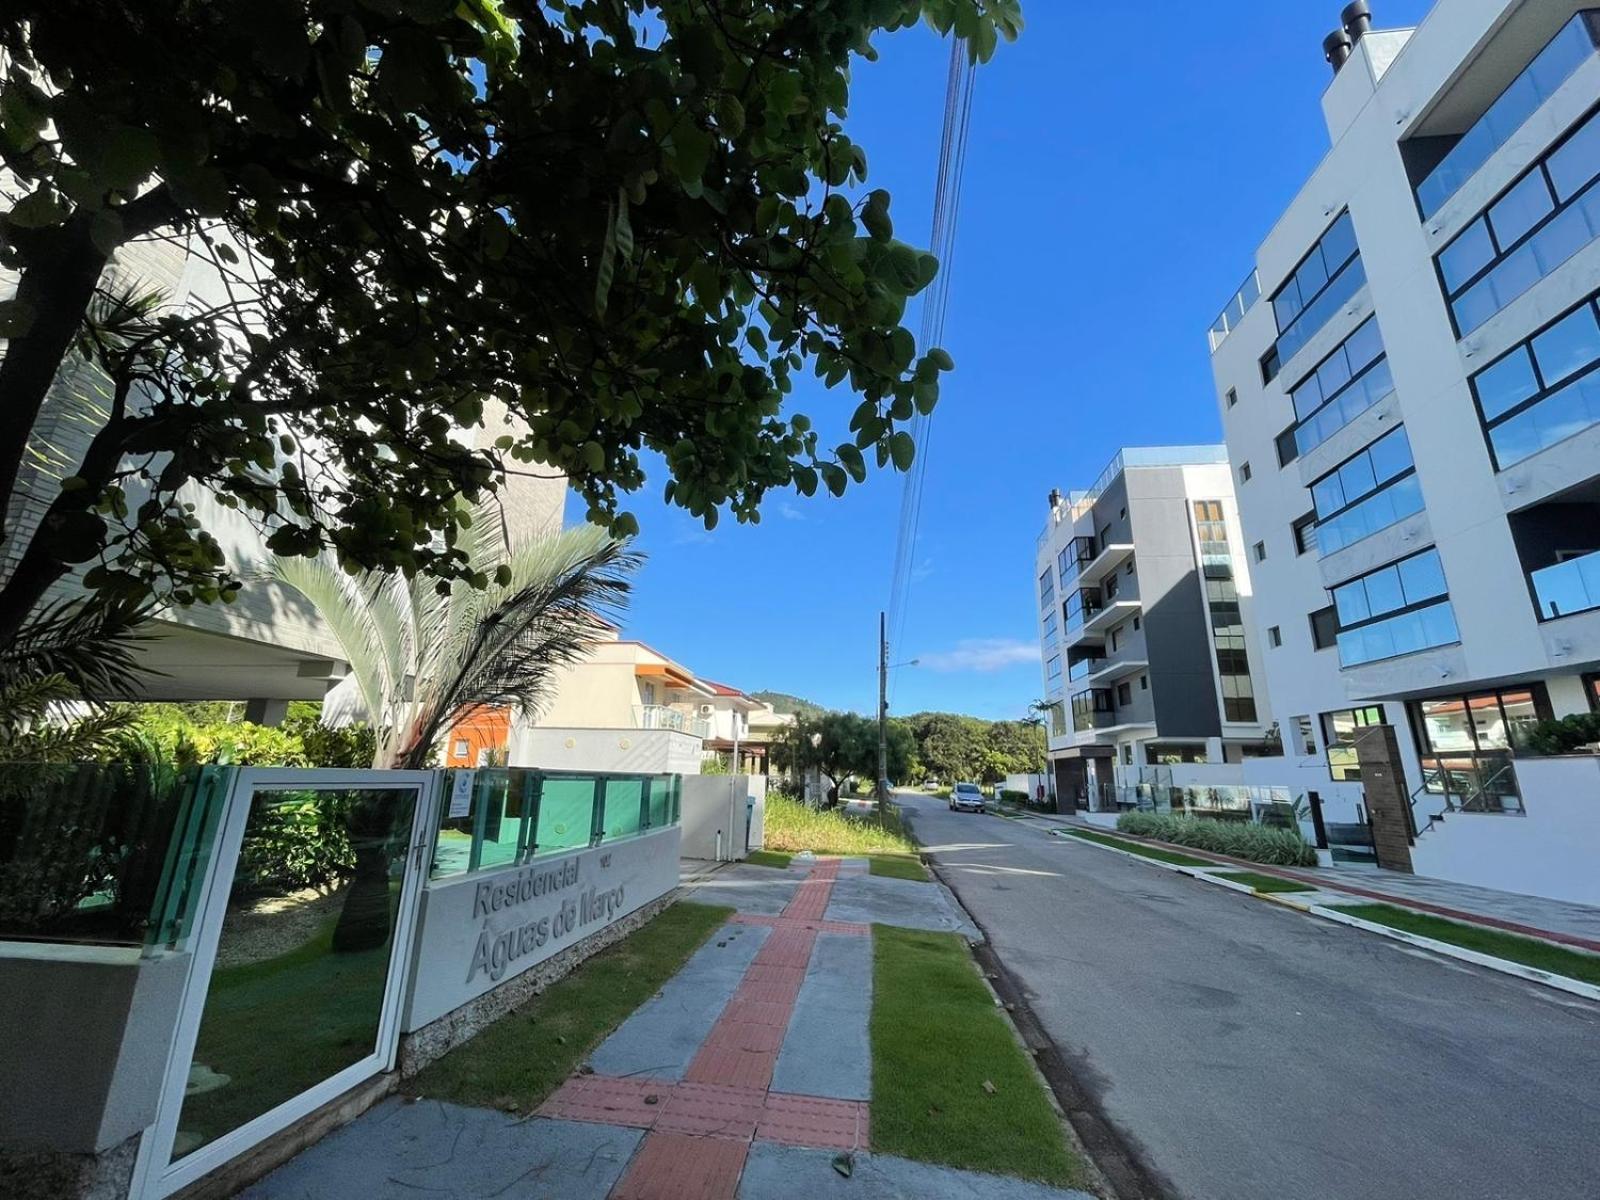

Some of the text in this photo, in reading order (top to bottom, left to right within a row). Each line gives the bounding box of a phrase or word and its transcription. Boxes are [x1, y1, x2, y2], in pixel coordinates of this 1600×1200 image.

[472, 855, 580, 919] Residencial
[465, 883, 625, 984] Águas de Março
